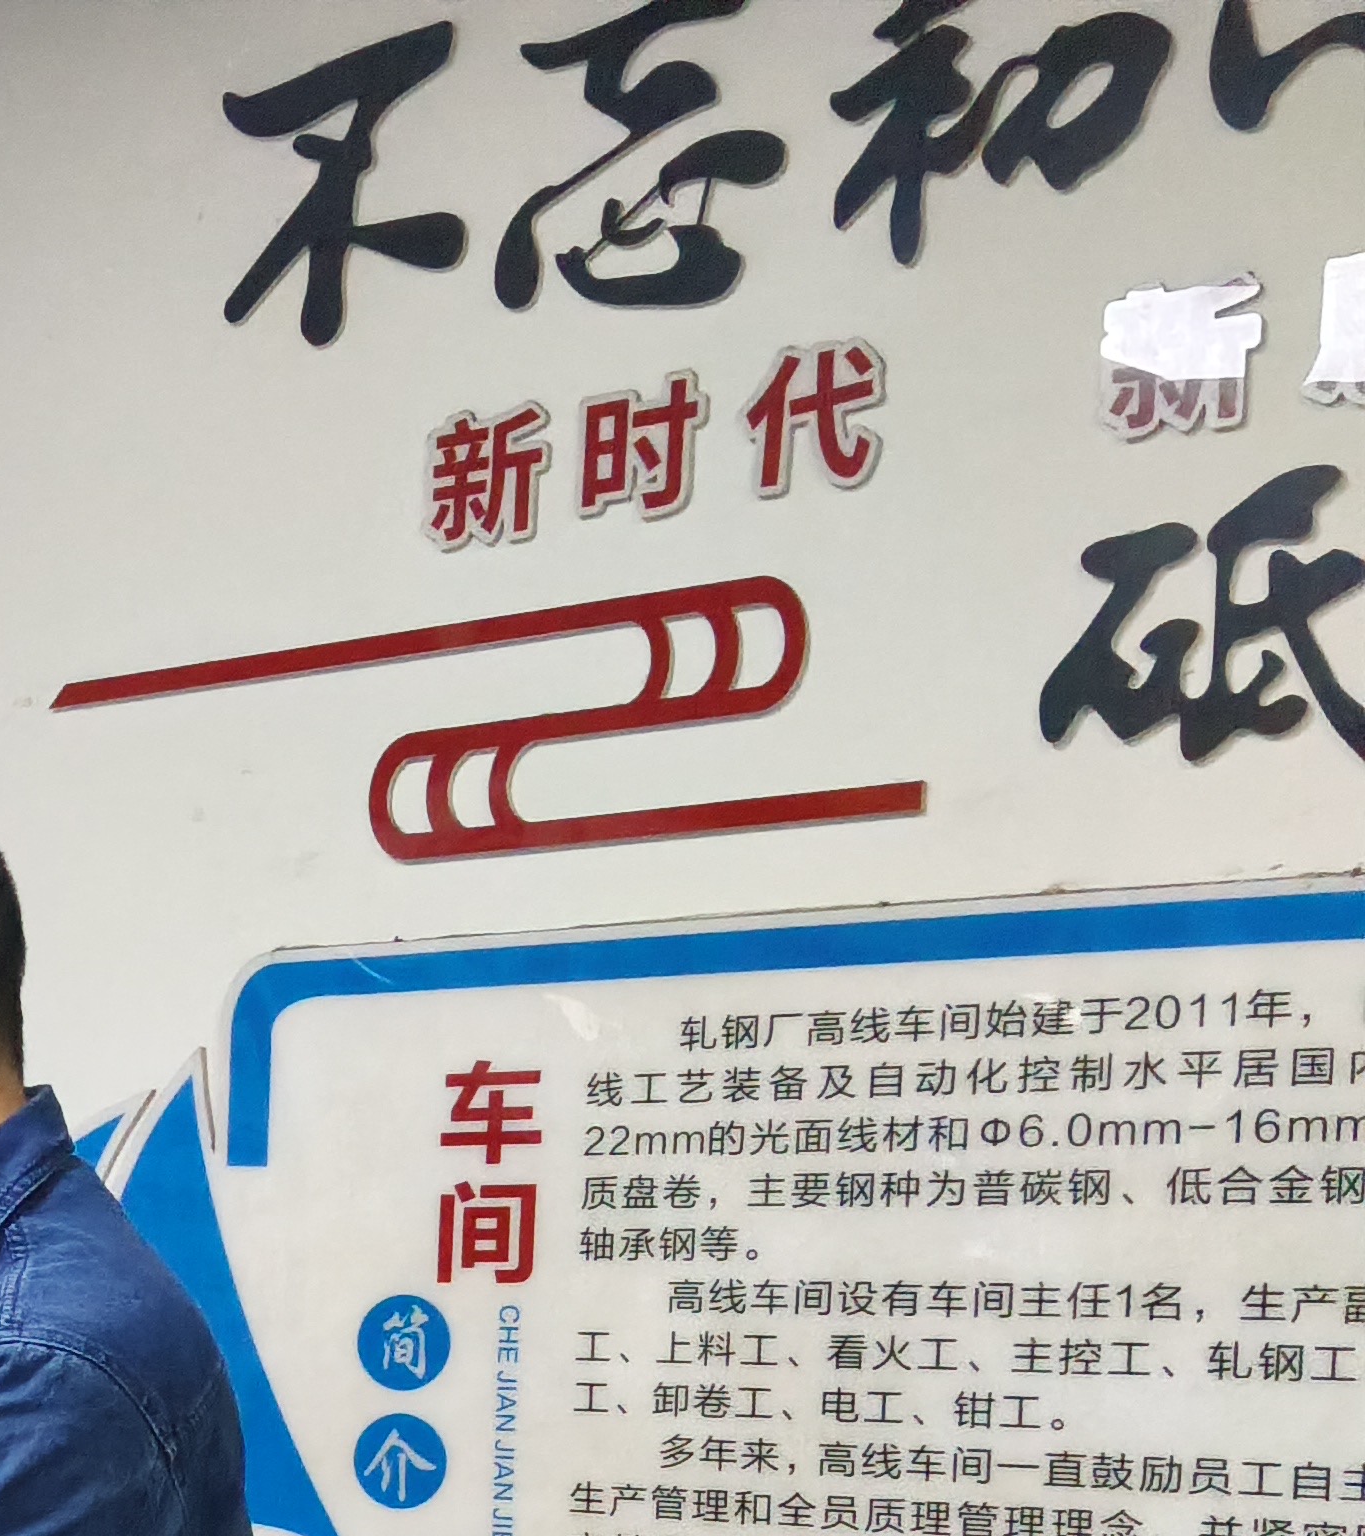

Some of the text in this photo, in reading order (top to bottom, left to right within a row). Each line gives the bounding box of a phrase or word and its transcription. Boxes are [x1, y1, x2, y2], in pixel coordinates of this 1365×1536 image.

[222, 0, 1365, 347] 不忘初
[429, 342, 881, 547] 新时代
[436, 1060, 543, 1284] 车间
[579, 1226, 760, 1262] 轴承钢等。
[497, 1305, 520, 1363] CHE
[495, 1371, 518, 1432] JIAN
[493, 1439, 516, 1501] JIAN
